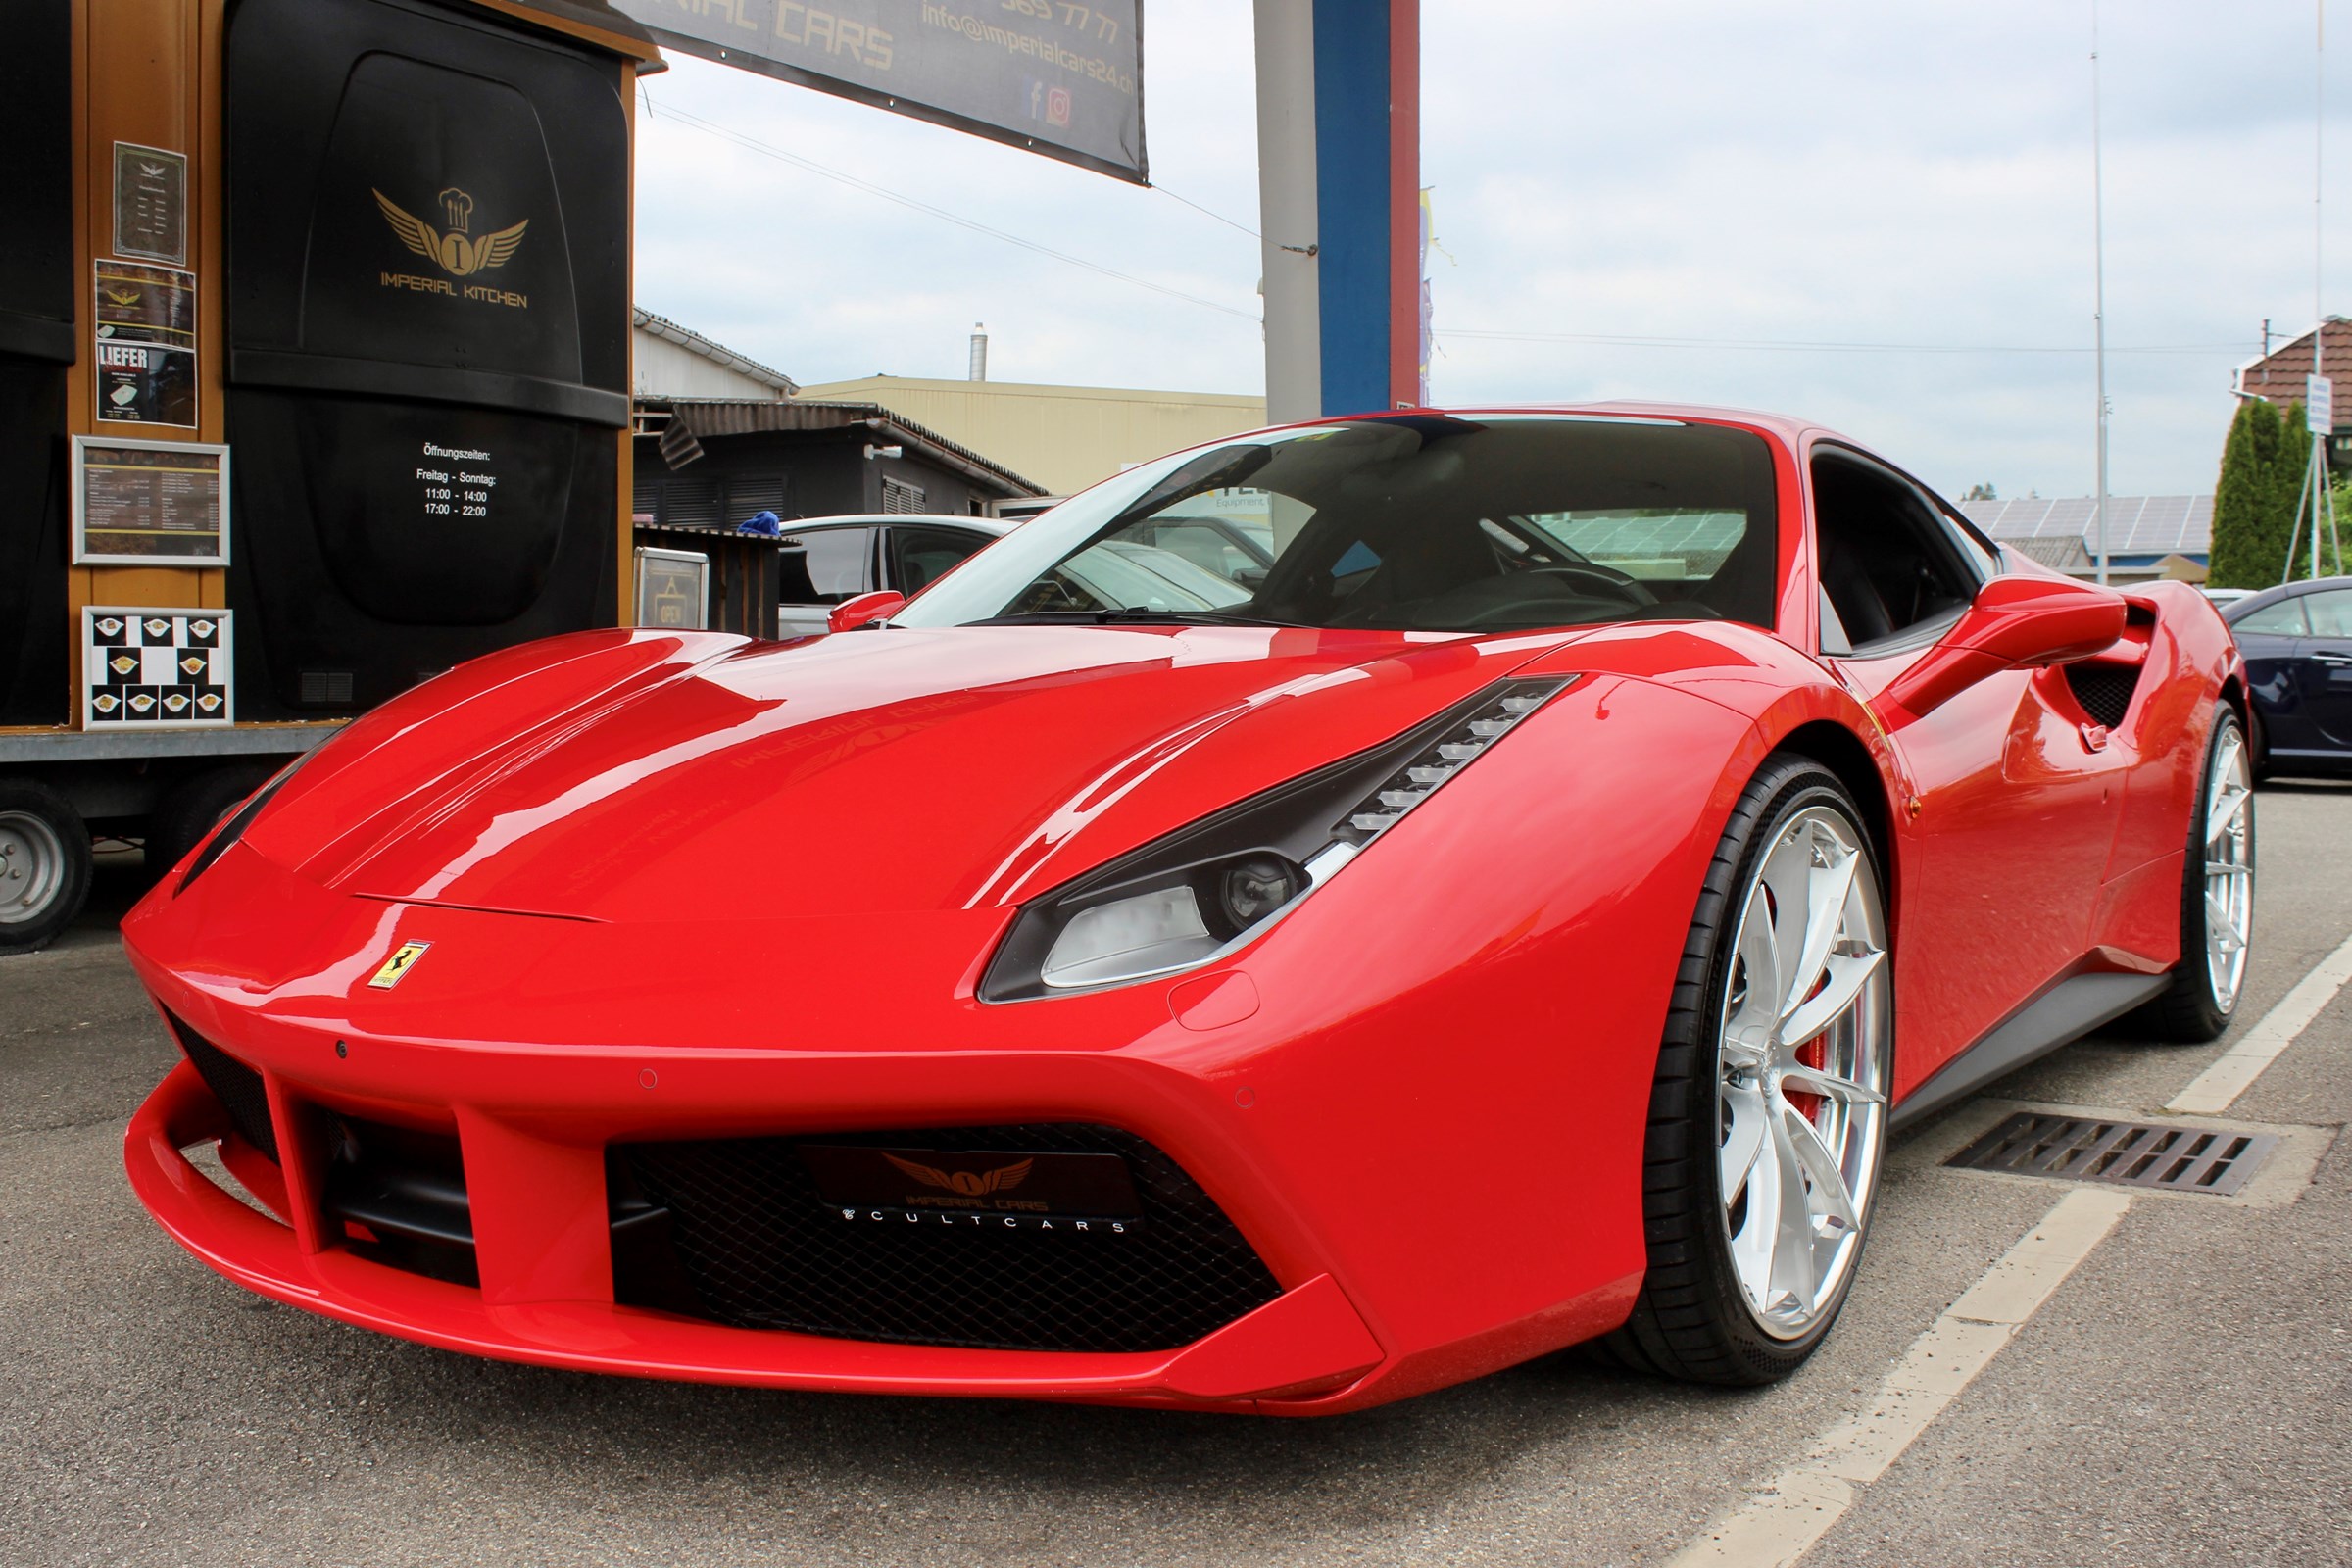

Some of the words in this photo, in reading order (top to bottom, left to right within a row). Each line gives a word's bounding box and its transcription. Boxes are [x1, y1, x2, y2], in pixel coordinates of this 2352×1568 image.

[774, 2, 894, 71] CARS
[921, 0, 1134, 94] info@imperialcars24.ch
[380, 271, 458, 297] IMPERIAL
[463, 284, 528, 309] KITCHEN
[99, 345, 147, 368] LIEFER
[423, 442, 490, 461] Öffnungszeiten:
[416, 468, 449, 483] Freitag
[459, 471, 497, 487] Sonntag:
[425, 488, 451, 499] 11:00
[464, 490, 487, 502] 14:00
[424, 503, 450, 514] 17:00
[462, 506, 487, 516] 22:00
[906, 1195, 989, 1209] IMPERIAL
[995, 1200, 1049, 1212] CARS
